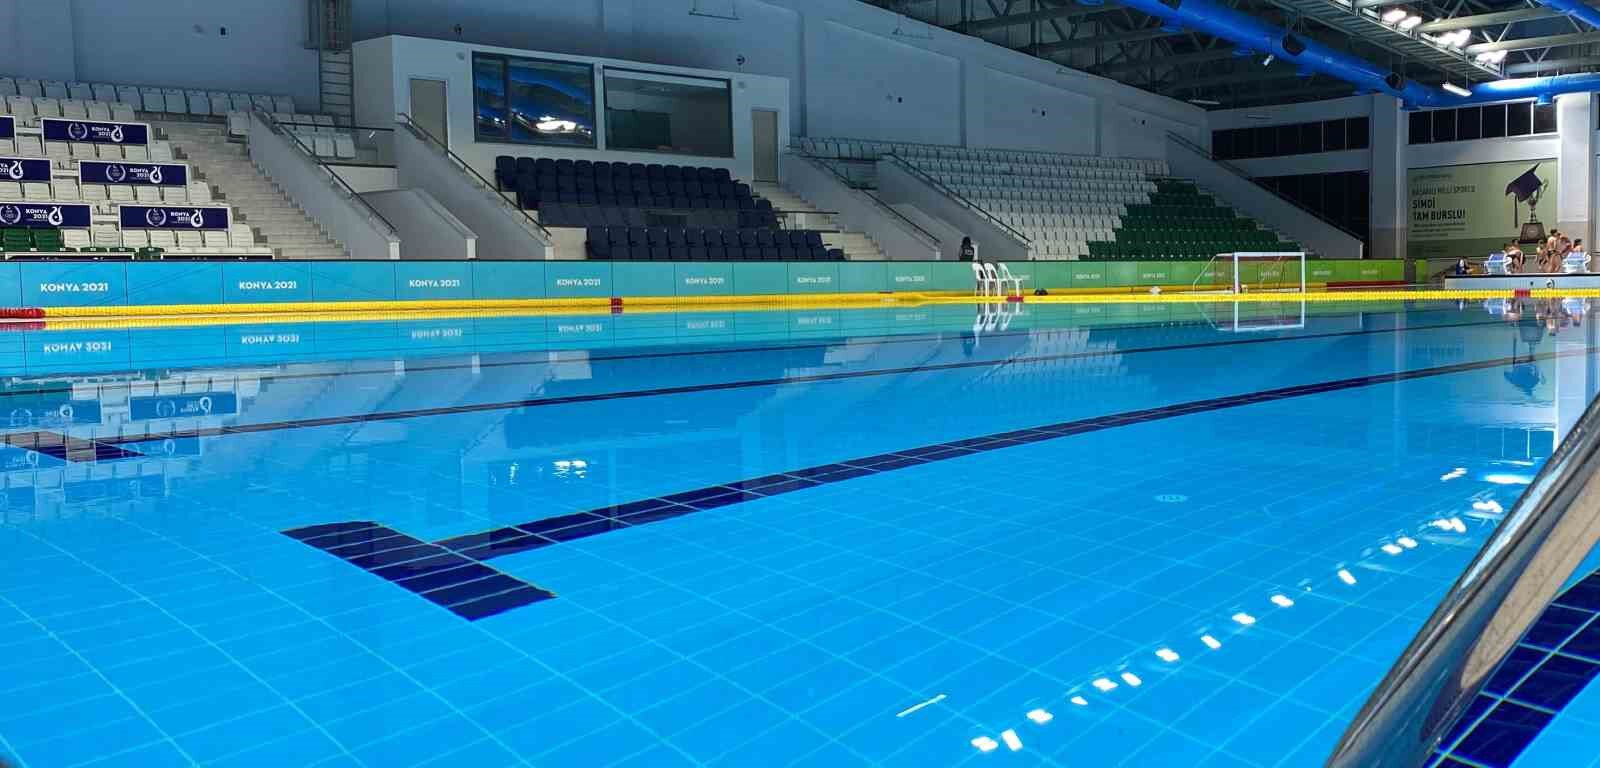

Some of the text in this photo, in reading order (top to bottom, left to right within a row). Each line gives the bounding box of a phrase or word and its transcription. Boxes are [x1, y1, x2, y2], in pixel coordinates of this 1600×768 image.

[1413, 209, 1466, 221] TAM BURSLU!
[239, 280, 297, 289] KONYA 2021
[409, 279, 461, 288] KONYA 2021
[556, 278, 601, 287] KONYA 2021
[40, 282, 109, 293] KONYA 2021
